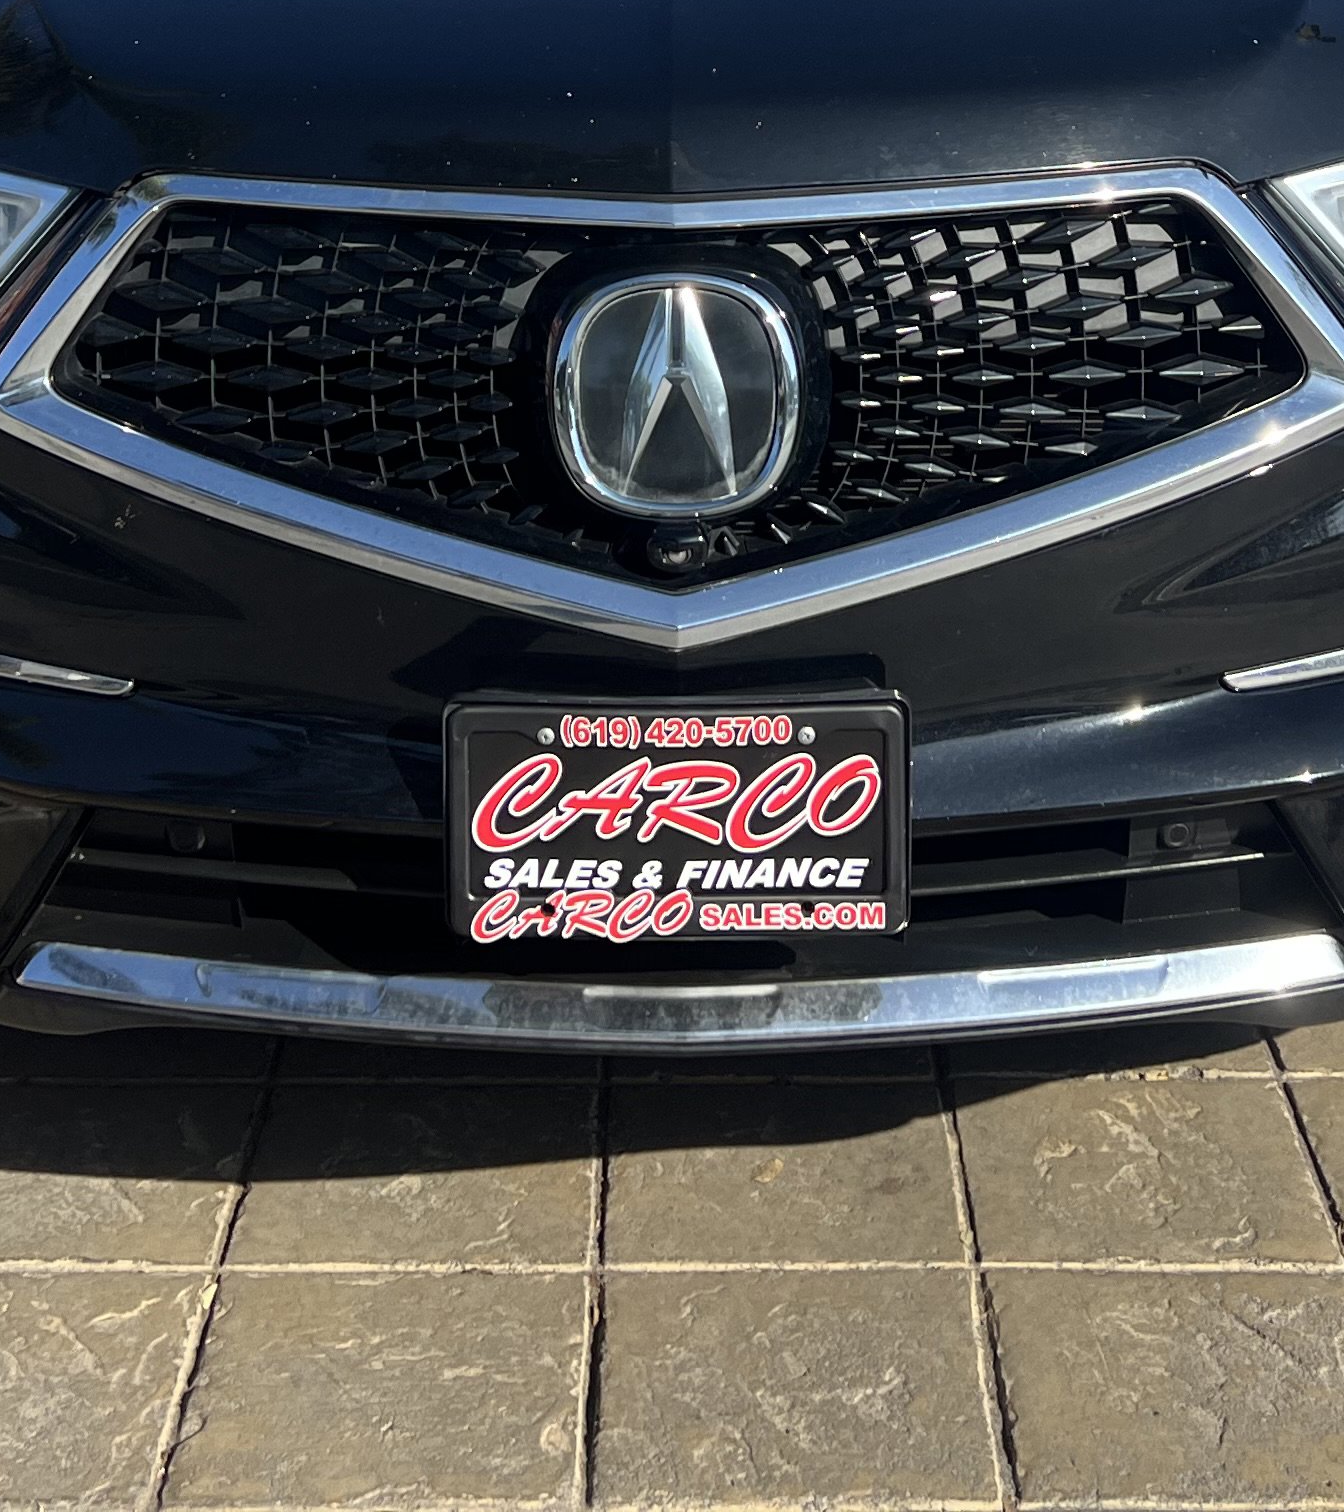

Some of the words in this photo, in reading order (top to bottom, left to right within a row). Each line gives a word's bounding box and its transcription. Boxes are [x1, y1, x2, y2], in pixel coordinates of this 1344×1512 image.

[559, 715, 641, 749] (619)
[645, 715, 792, 747] 420-5700
[471, 752, 881, 853] CARCO
[484, 857, 623, 889] SALES
[632, 859, 663, 890] &
[676, 857, 869, 889] FINANCE
[470, 888, 693, 944] CARCO
[699, 901, 887, 932] SALES.COM
